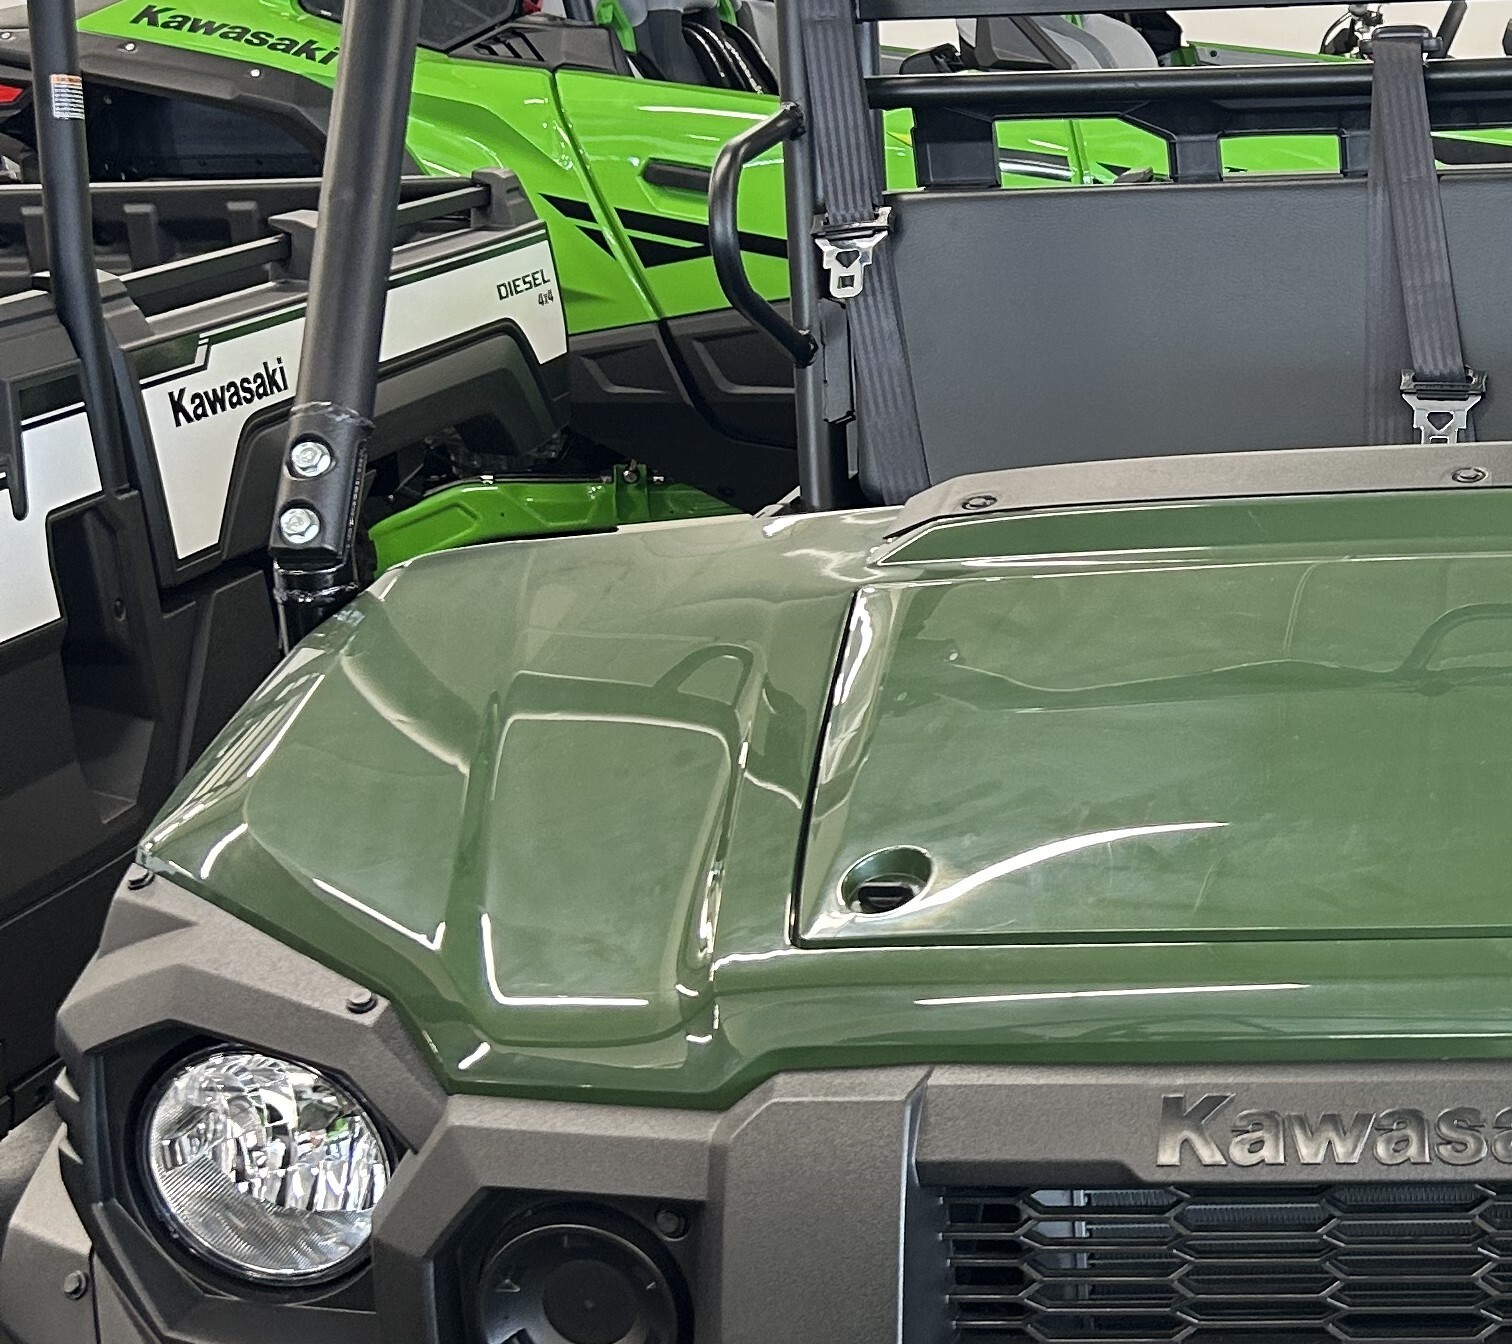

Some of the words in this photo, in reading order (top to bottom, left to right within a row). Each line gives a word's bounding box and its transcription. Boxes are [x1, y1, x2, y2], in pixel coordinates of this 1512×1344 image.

[129, 4, 341, 66] Kawasaki
[496, 268, 551, 301] DIESEL
[538, 288, 554, 306] 4x4
[167, 357, 289, 428] Kawasaki
